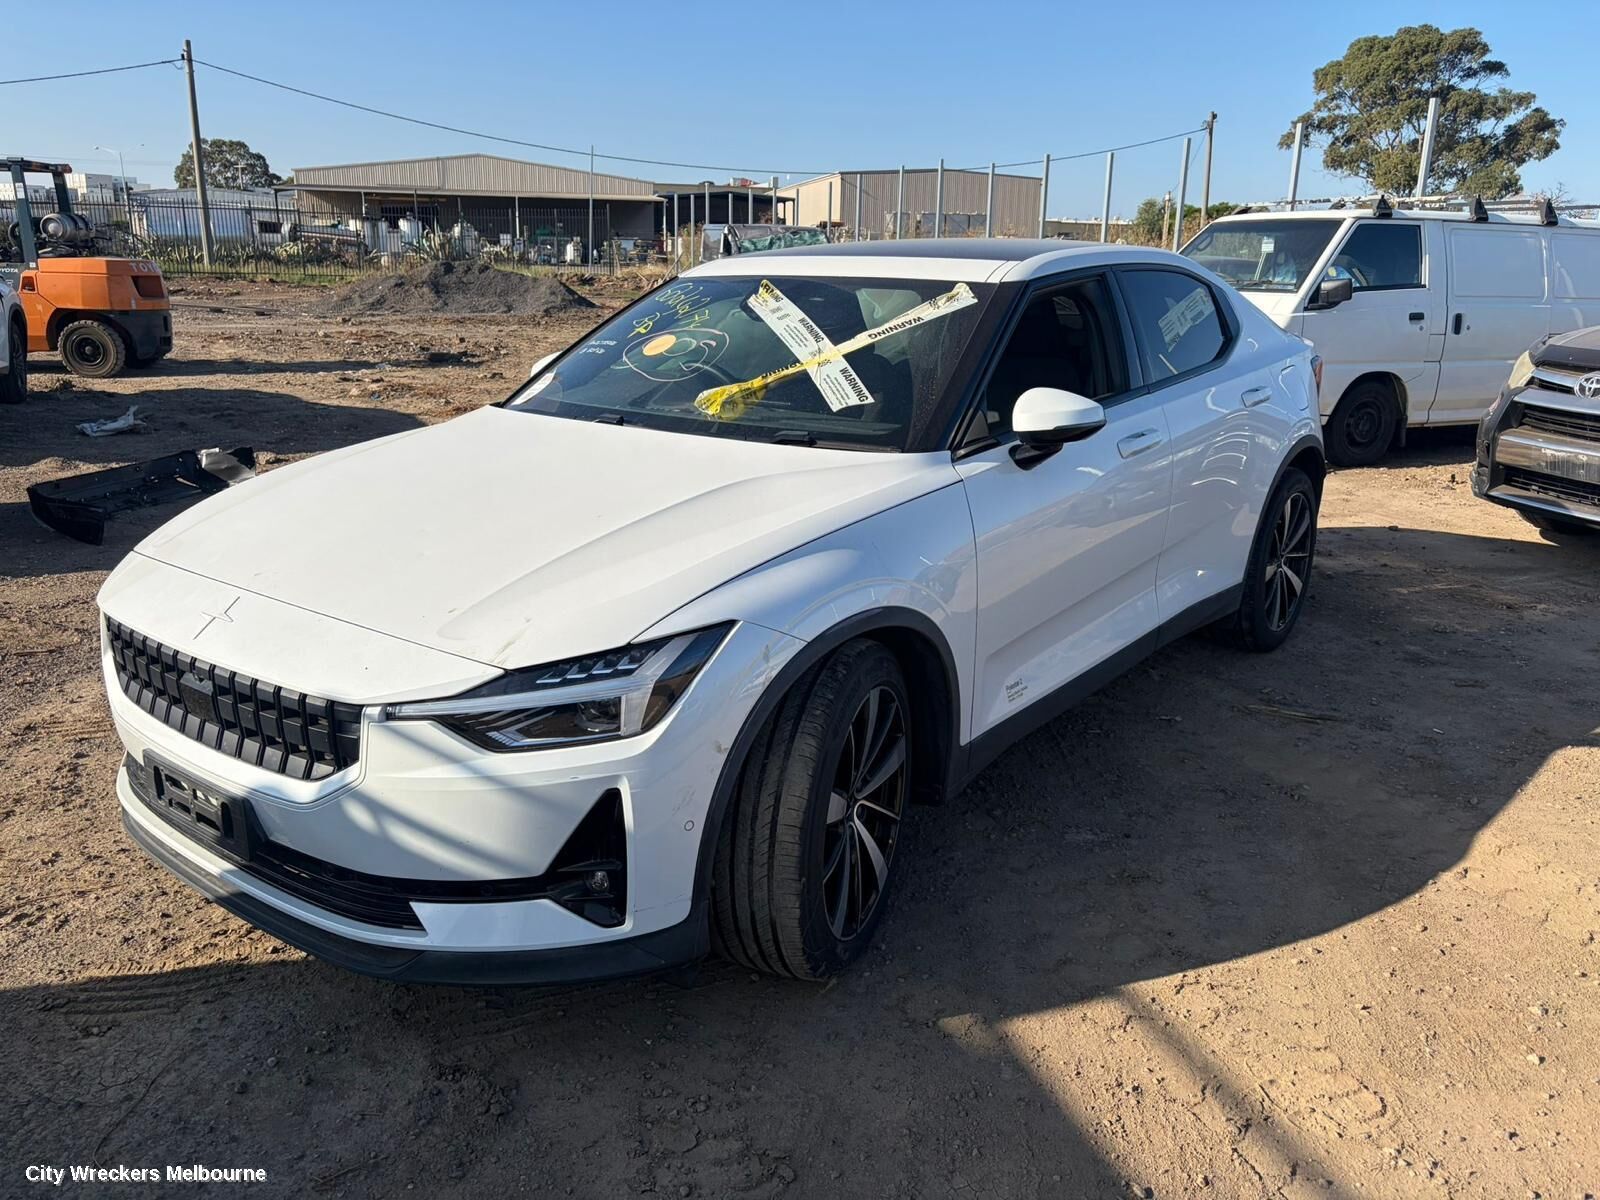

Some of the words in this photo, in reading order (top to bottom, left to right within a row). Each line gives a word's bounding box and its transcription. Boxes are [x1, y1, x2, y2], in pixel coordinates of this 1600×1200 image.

[798, 316, 825, 344] WARNING
[867, 316, 925, 340] WARNING
[839, 366, 869, 403] WARNING
